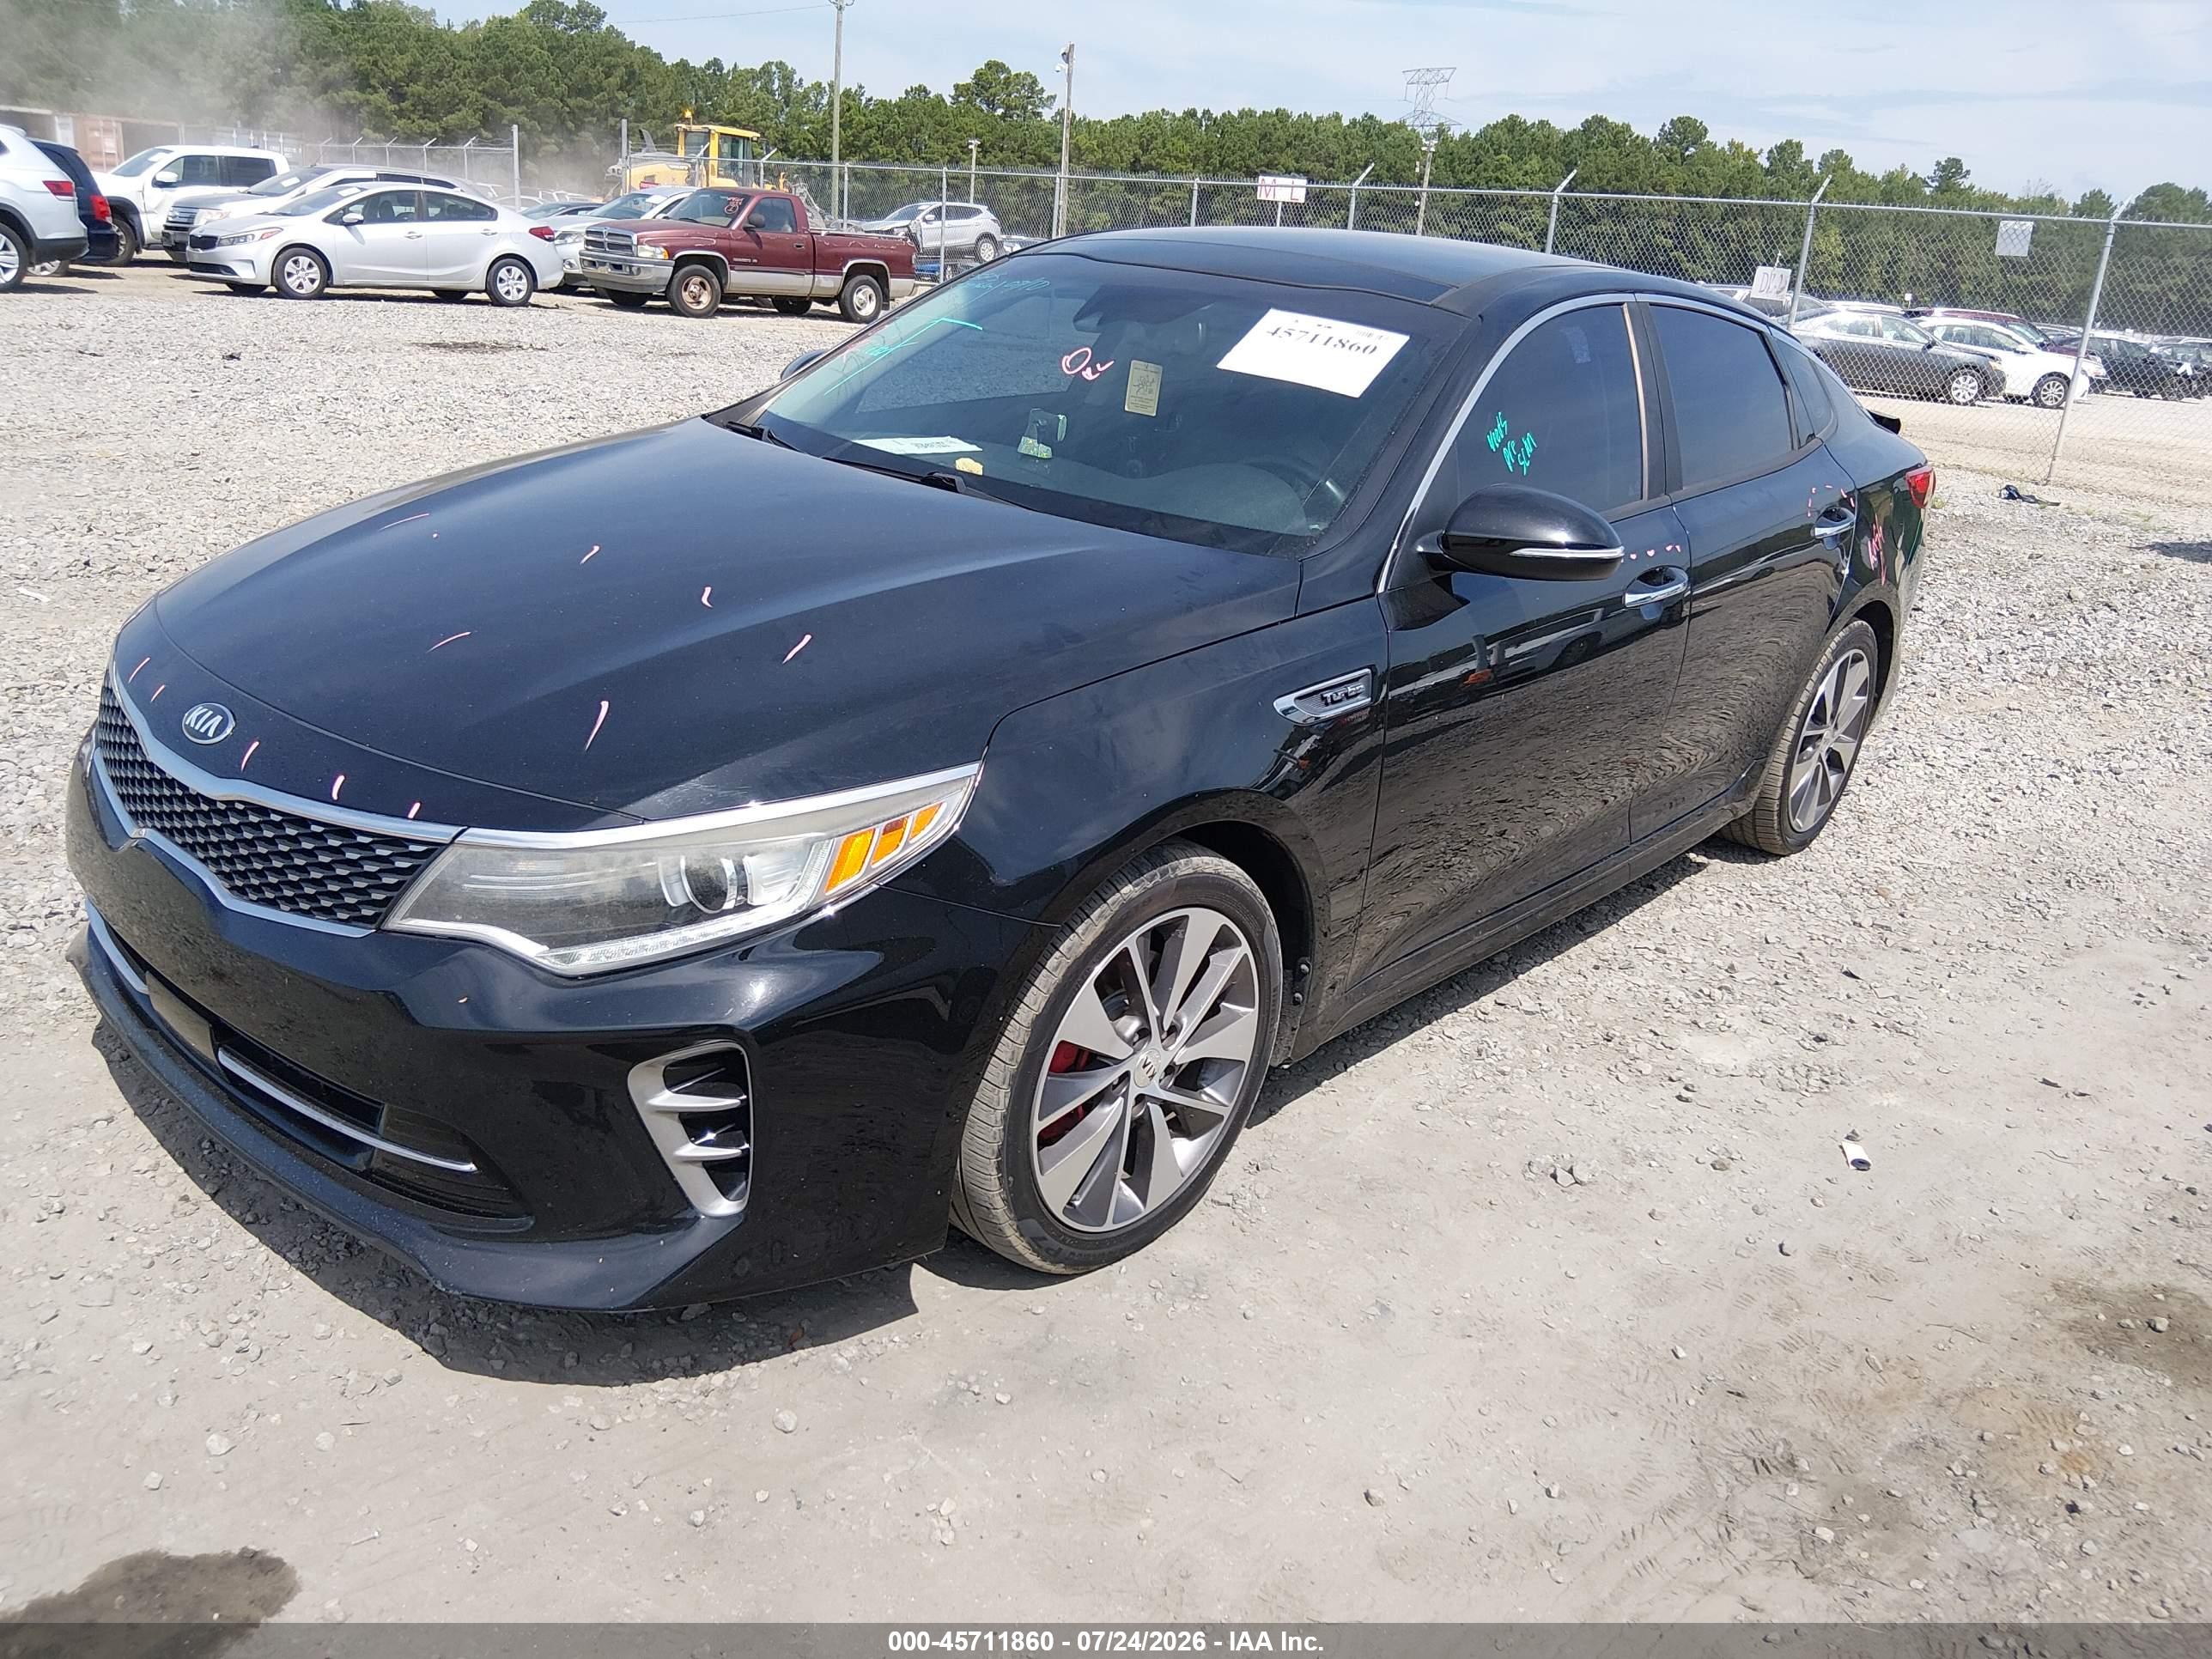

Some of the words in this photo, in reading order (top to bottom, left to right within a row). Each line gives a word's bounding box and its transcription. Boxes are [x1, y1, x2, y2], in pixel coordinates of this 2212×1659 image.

[1266, 325, 1379, 356] 45711860
[185, 706, 223, 738] KIA
[1141, 1056, 1158, 1082] KIA
